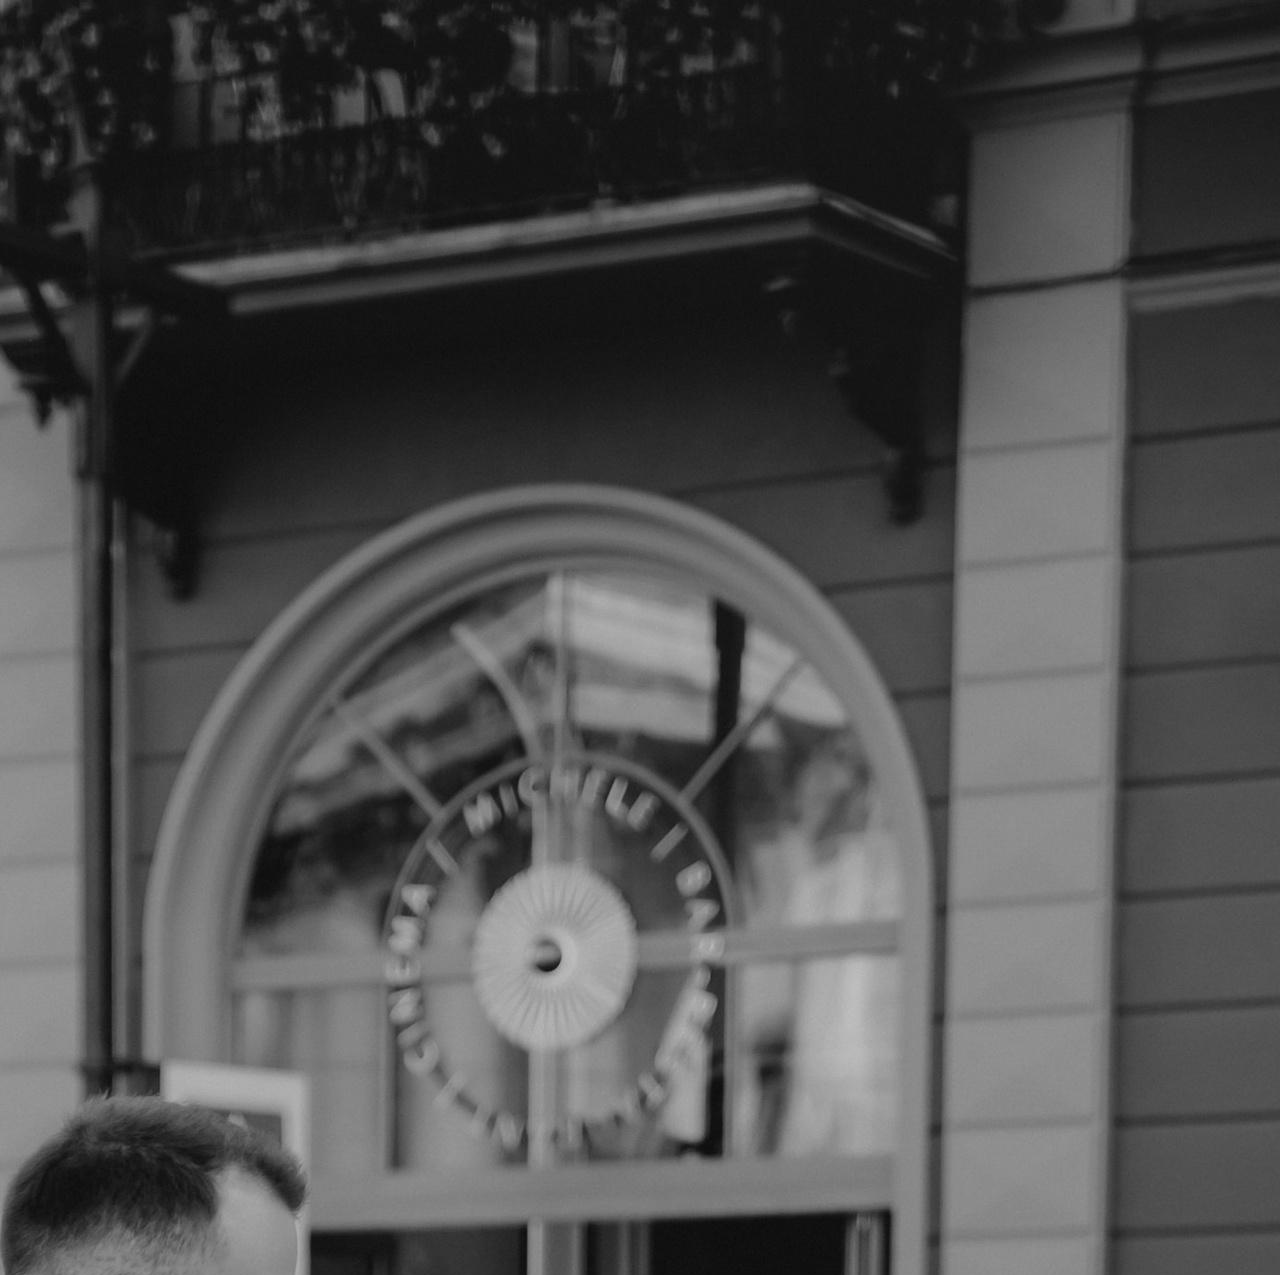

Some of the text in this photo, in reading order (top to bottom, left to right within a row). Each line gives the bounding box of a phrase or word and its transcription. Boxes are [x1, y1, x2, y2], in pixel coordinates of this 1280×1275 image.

[462, 766, 658, 835] MICHELE
[675, 858, 724, 964] BAR
[385, 882, 438, 1076] CINEMA
